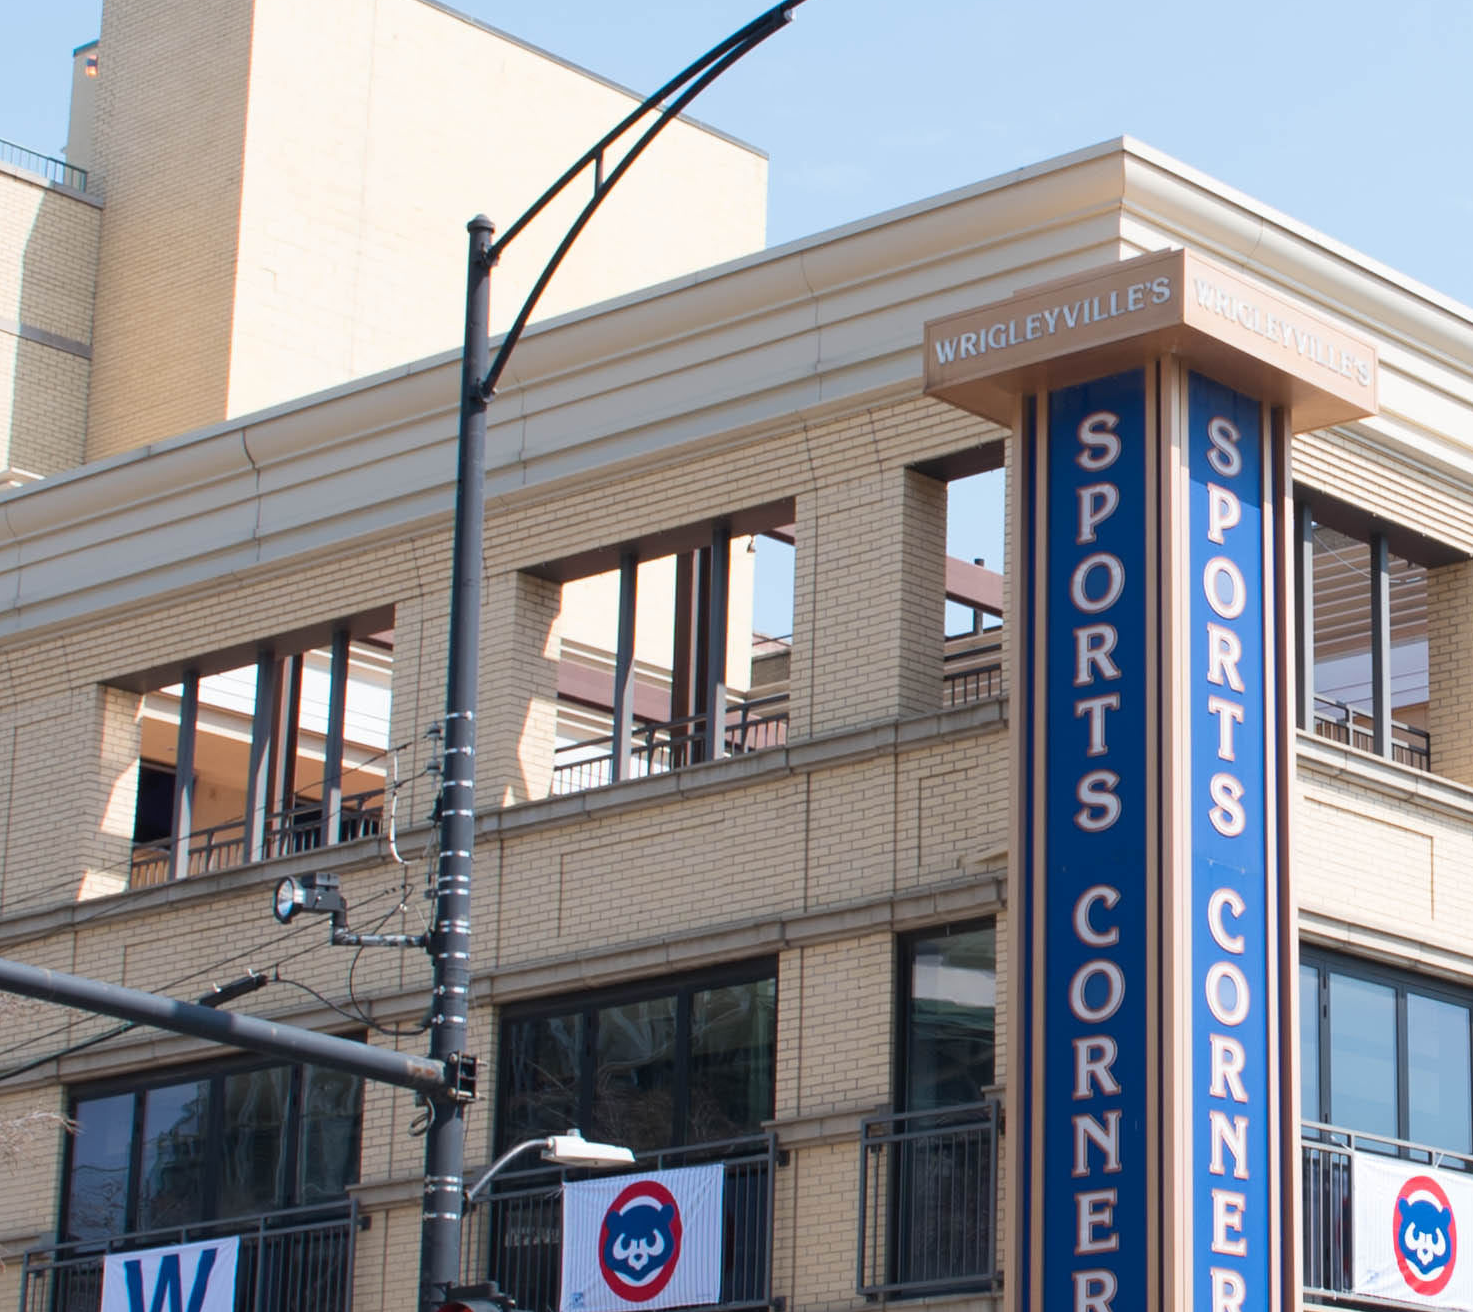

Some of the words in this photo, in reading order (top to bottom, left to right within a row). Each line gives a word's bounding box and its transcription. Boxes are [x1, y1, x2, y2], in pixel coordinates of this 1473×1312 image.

[935, 277, 1172, 365] WRIGLEYVILLE'S
[1194, 275, 1371, 387] WRIGLEYVILLE'S
[1070, 410, 1126, 832] SPORTS
[1202, 415, 1247, 838] SPORTS
